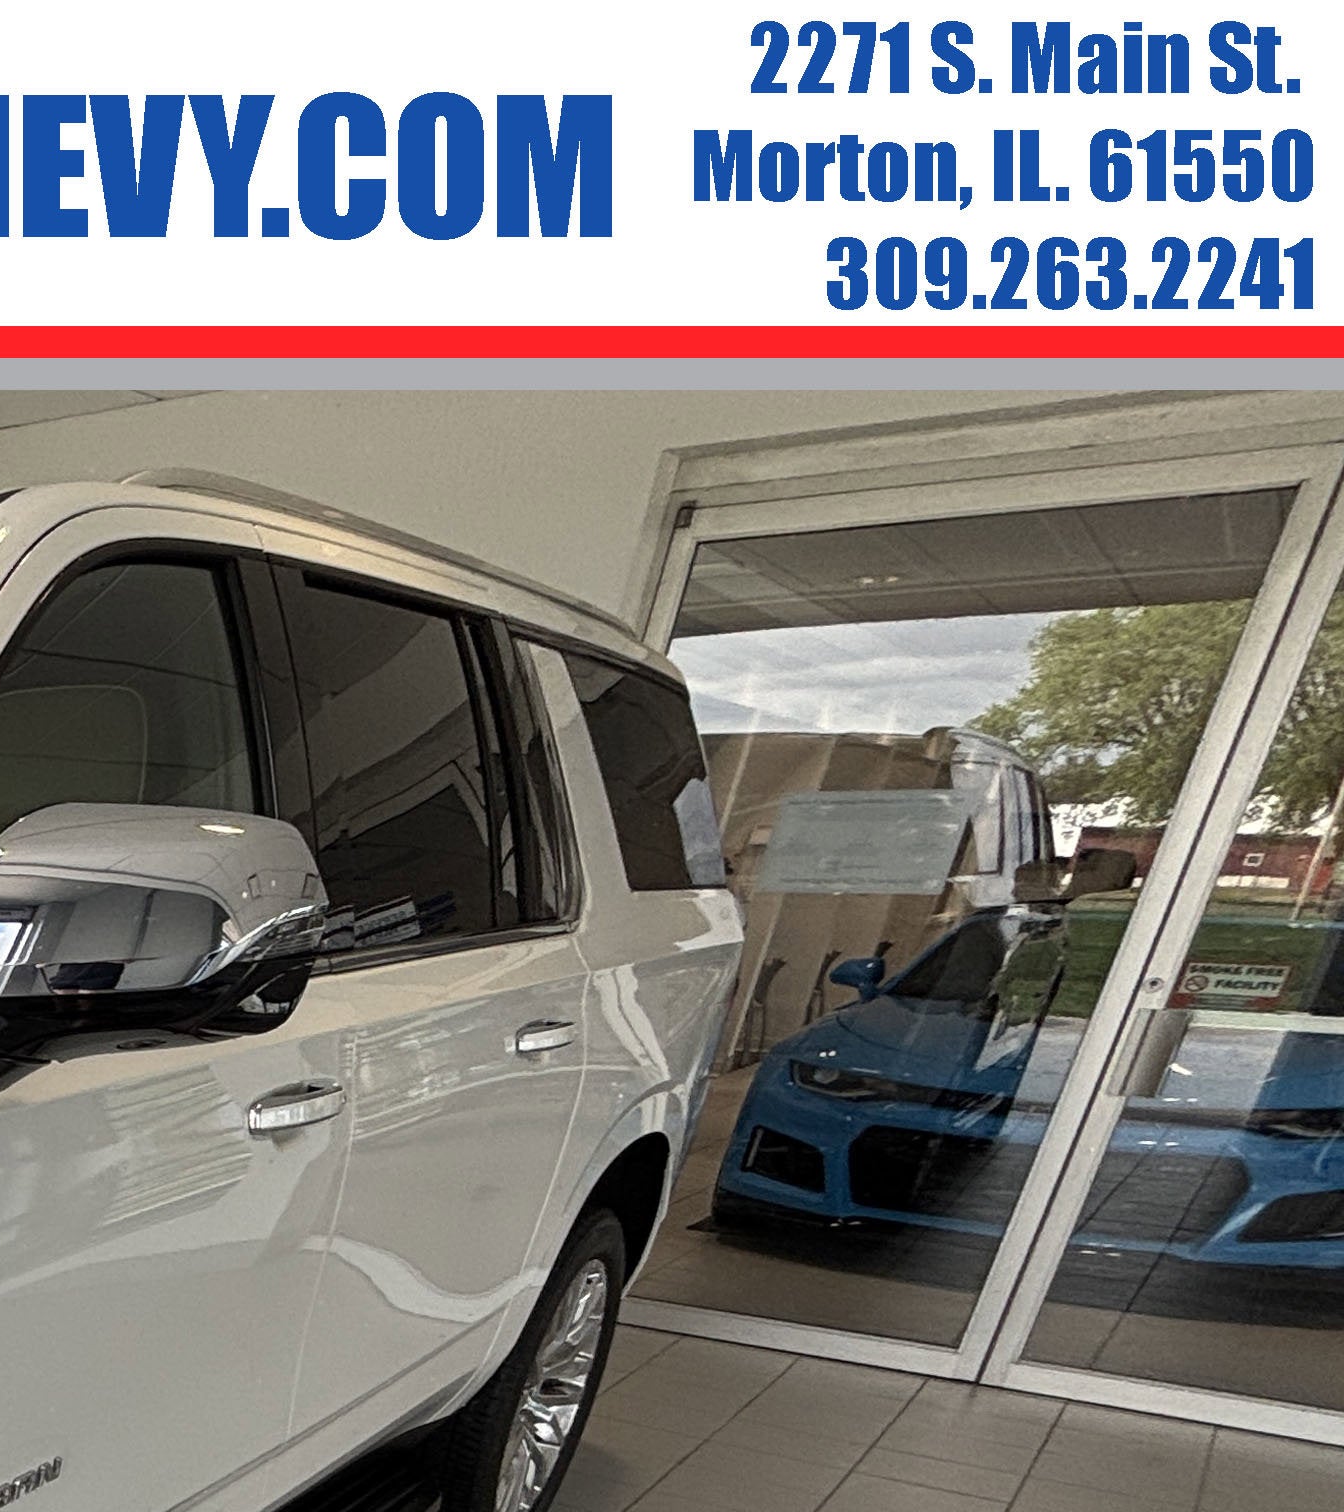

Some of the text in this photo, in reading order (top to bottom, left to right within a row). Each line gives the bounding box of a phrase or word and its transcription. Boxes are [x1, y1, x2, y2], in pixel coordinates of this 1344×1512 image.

[1189, 964, 1286, 977] SMOKE FREE
[1213, 978, 1281, 991] FACILITY
